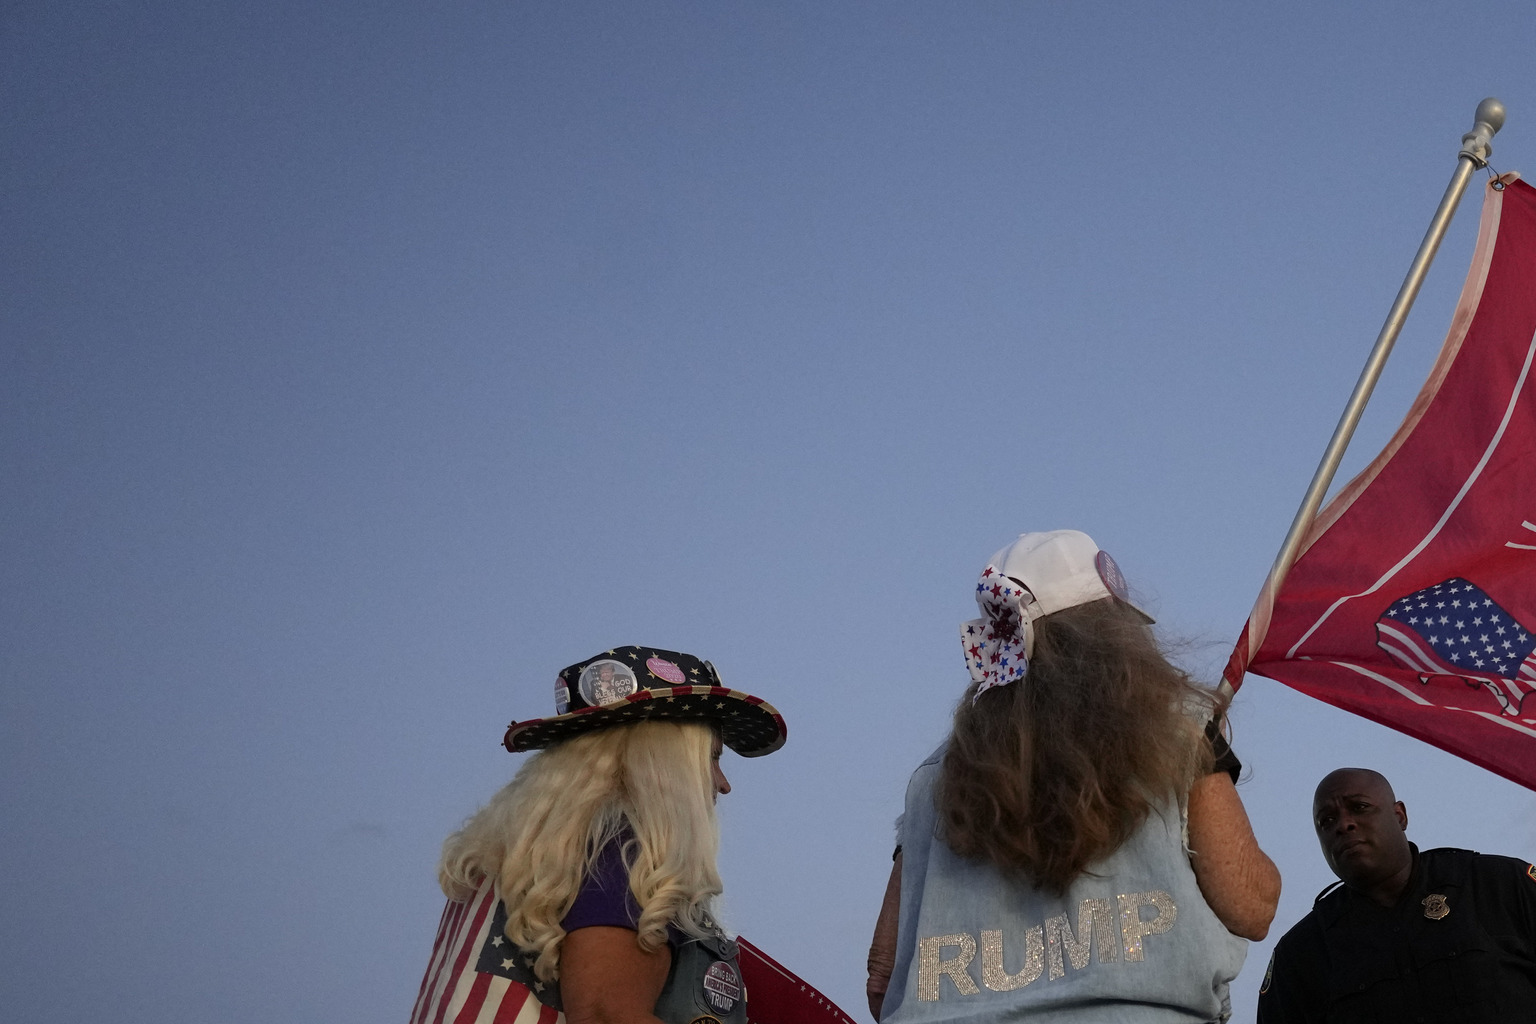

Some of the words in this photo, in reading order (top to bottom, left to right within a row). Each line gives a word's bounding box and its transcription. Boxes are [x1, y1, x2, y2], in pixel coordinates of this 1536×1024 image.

[615, 678, 631, 687] GOD
[594, 688, 615, 700] BLESS
[617, 685, 632, 694] OUR
[711, 965, 726, 980] BRING
[725, 971, 738, 985] BACK
[711, 991, 734, 1012] TRUMP
